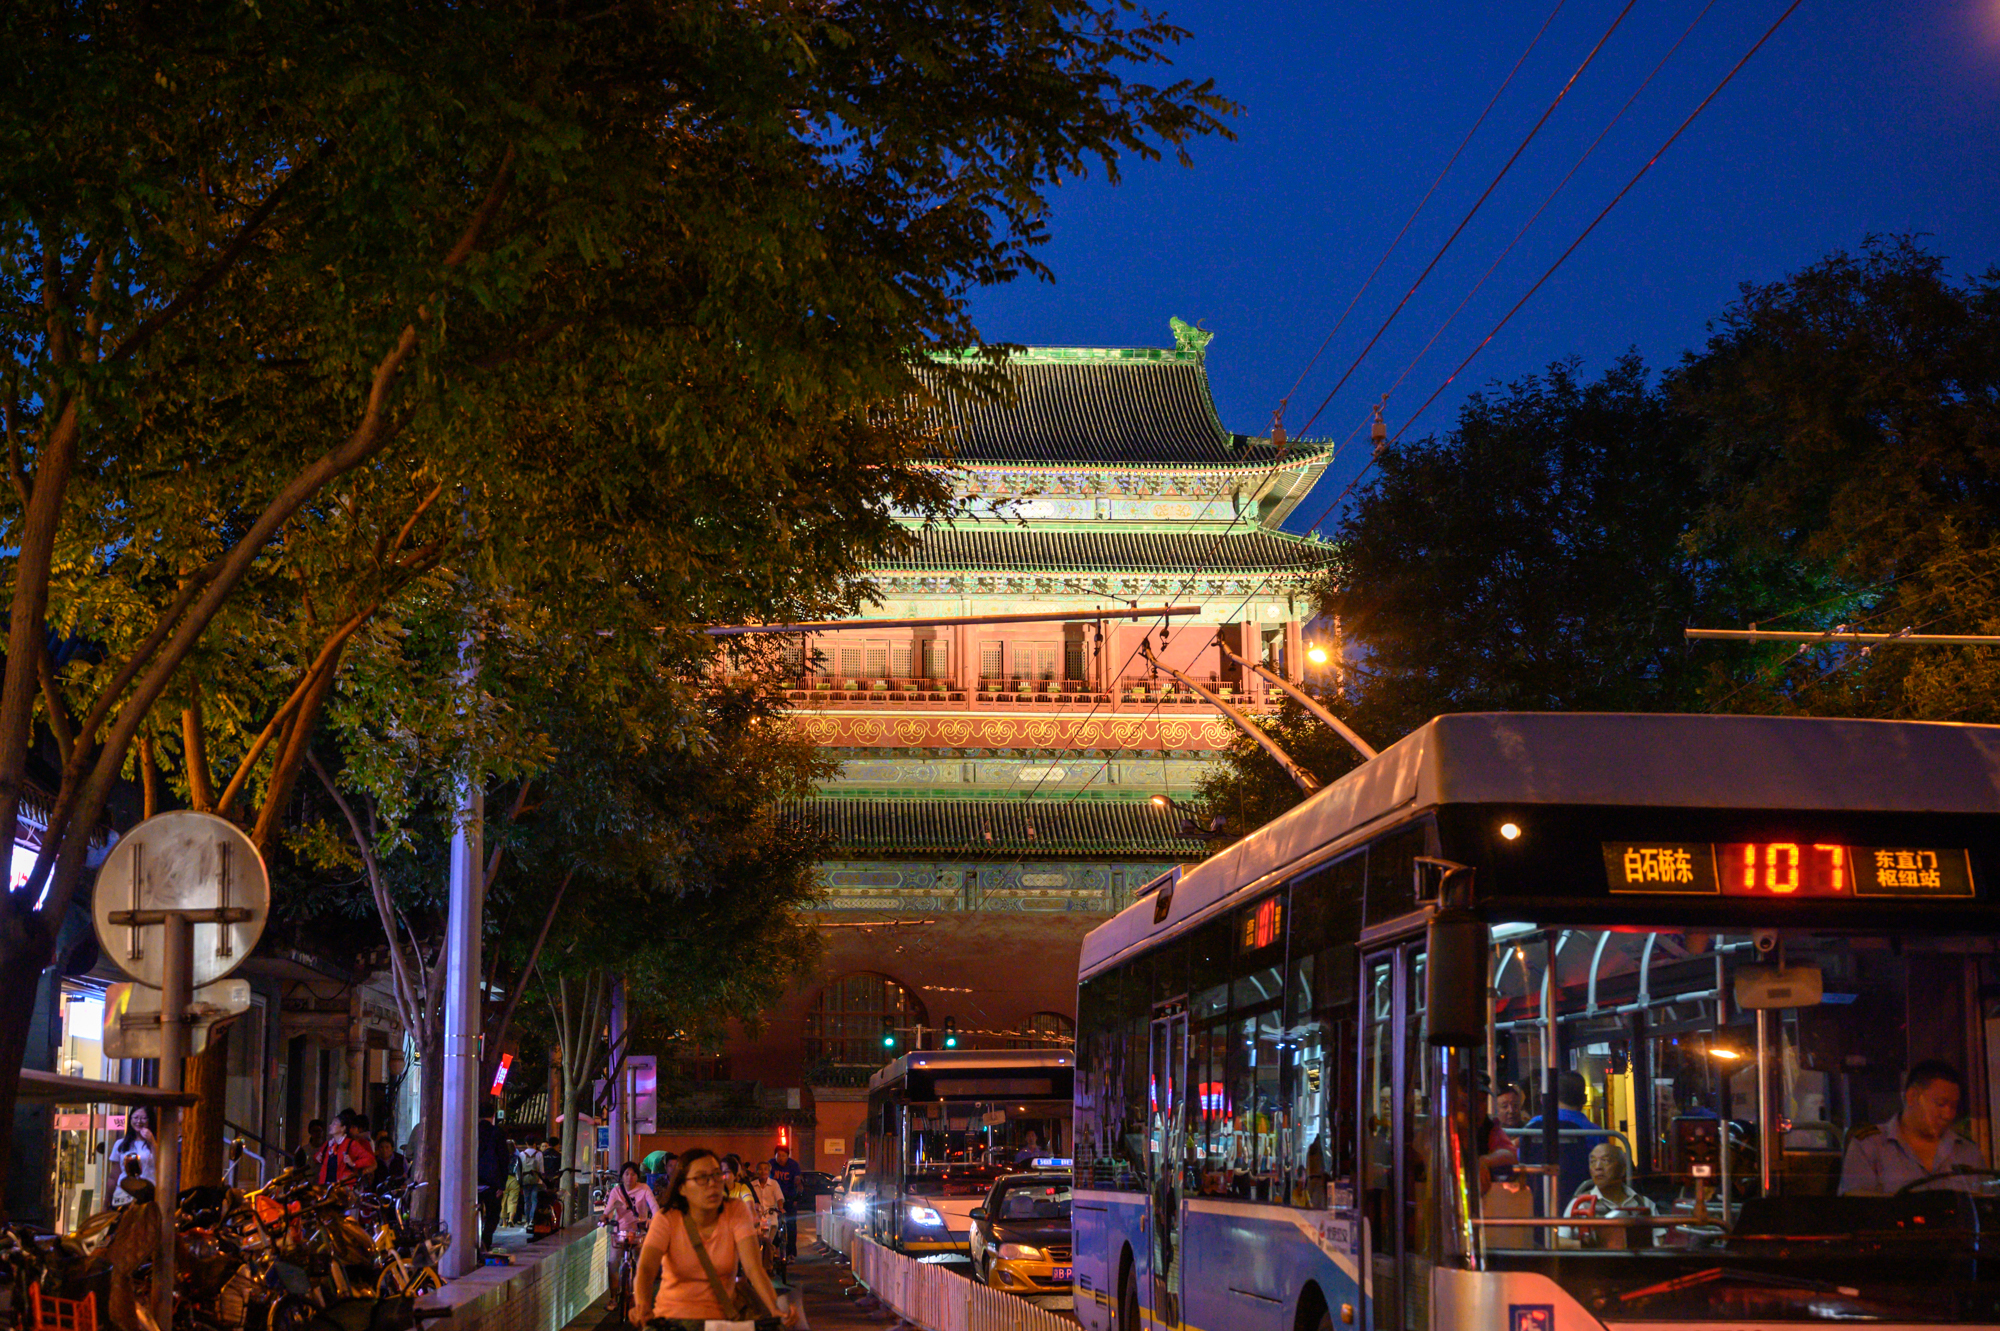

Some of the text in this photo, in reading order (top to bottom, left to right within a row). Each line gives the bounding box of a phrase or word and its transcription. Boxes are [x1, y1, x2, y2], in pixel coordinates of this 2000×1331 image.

[1624, 847, 1694, 883] 白石桥东
[1744, 843, 1843, 893] 107
[1874, 849, 1938, 869] 东直门
[1876, 868, 1941, 888] 枢纽站
[774, 1170, 790, 1180] NYC
